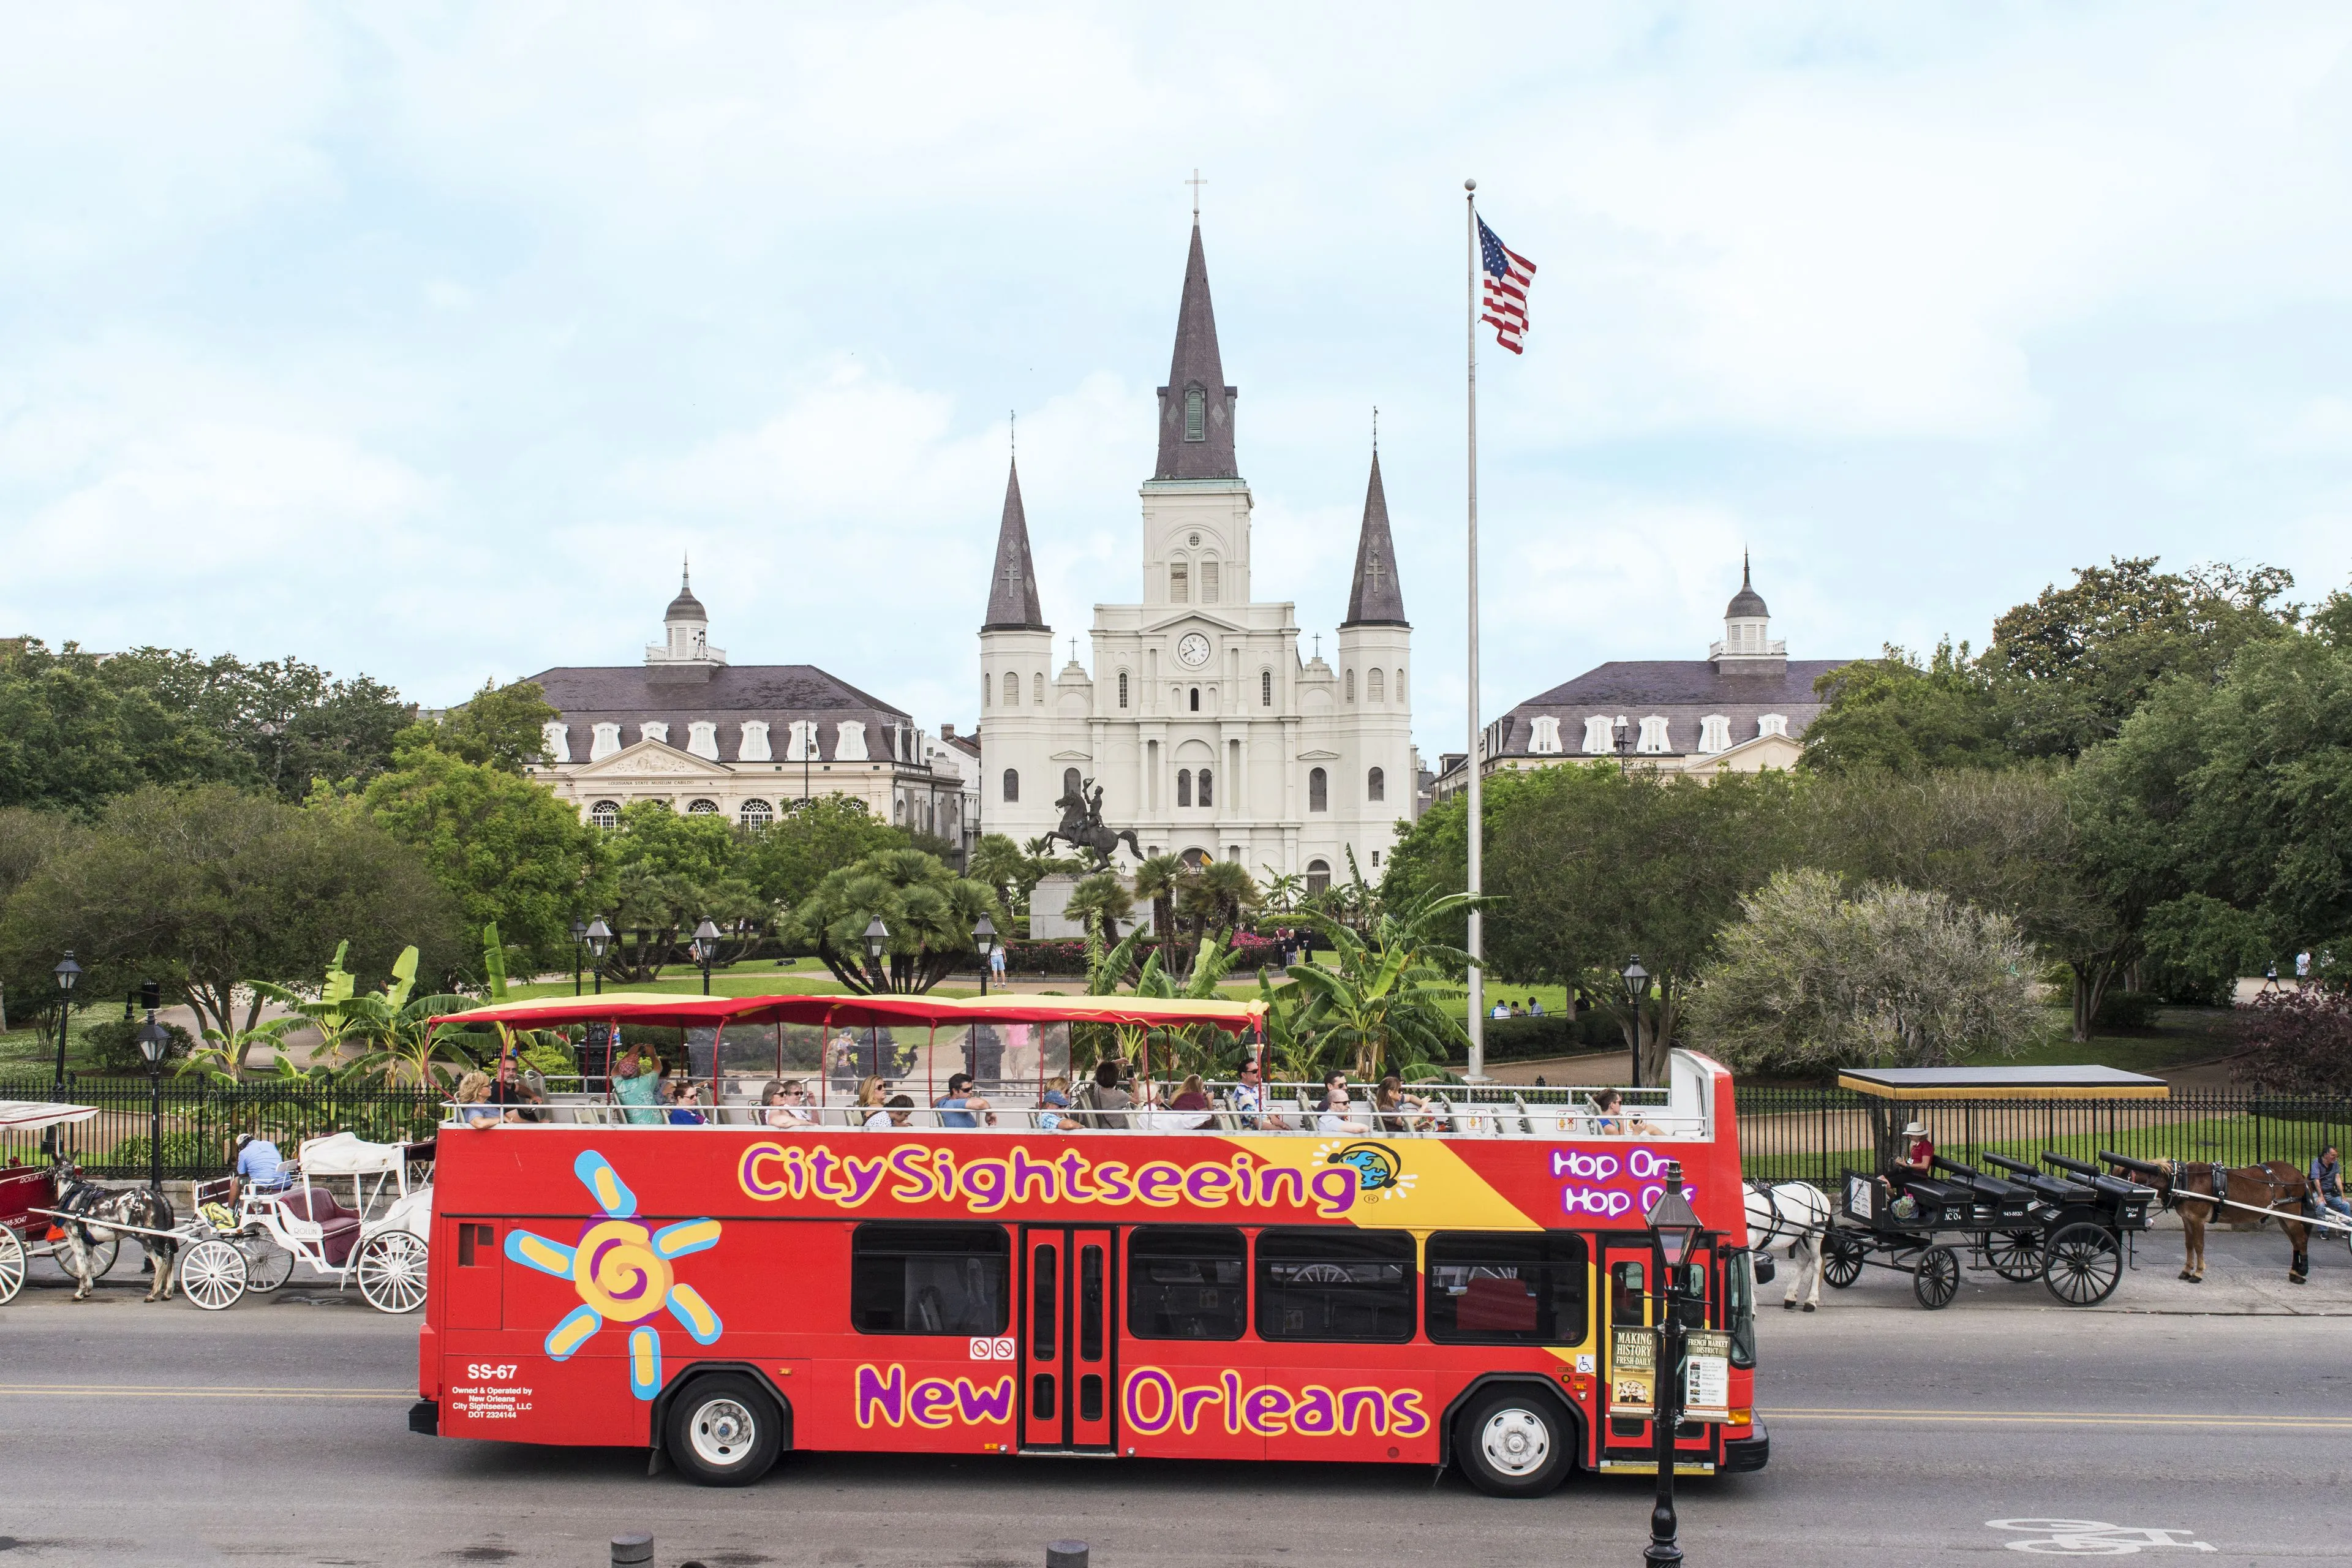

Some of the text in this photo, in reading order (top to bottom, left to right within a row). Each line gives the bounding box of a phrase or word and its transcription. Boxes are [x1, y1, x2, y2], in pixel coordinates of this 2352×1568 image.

[1554, 1152, 1618, 1181] Hop
[20, 1174, 39, 1184] ROLLIN
[739, 1143, 1360, 1217] CitySightseeing
[1566, 1188, 1630, 1216] Hop
[1617, 1332, 1653, 1345] MAKING
[1707, 1340, 1728, 1348] MARKET
[1616, 1344, 1652, 1357] HISTORY
[1616, 1356, 1652, 1366] FRESH DAILY
[467, 1363, 518, 1379] SS-67
[487, 1387, 521, 1395] Operated
[522, 1387, 533, 1396] by
[452, 1402, 467, 1411] City
[469, 1402, 515, 1411] Sightseeing,
[856, 1364, 1430, 1437] New Orleans
